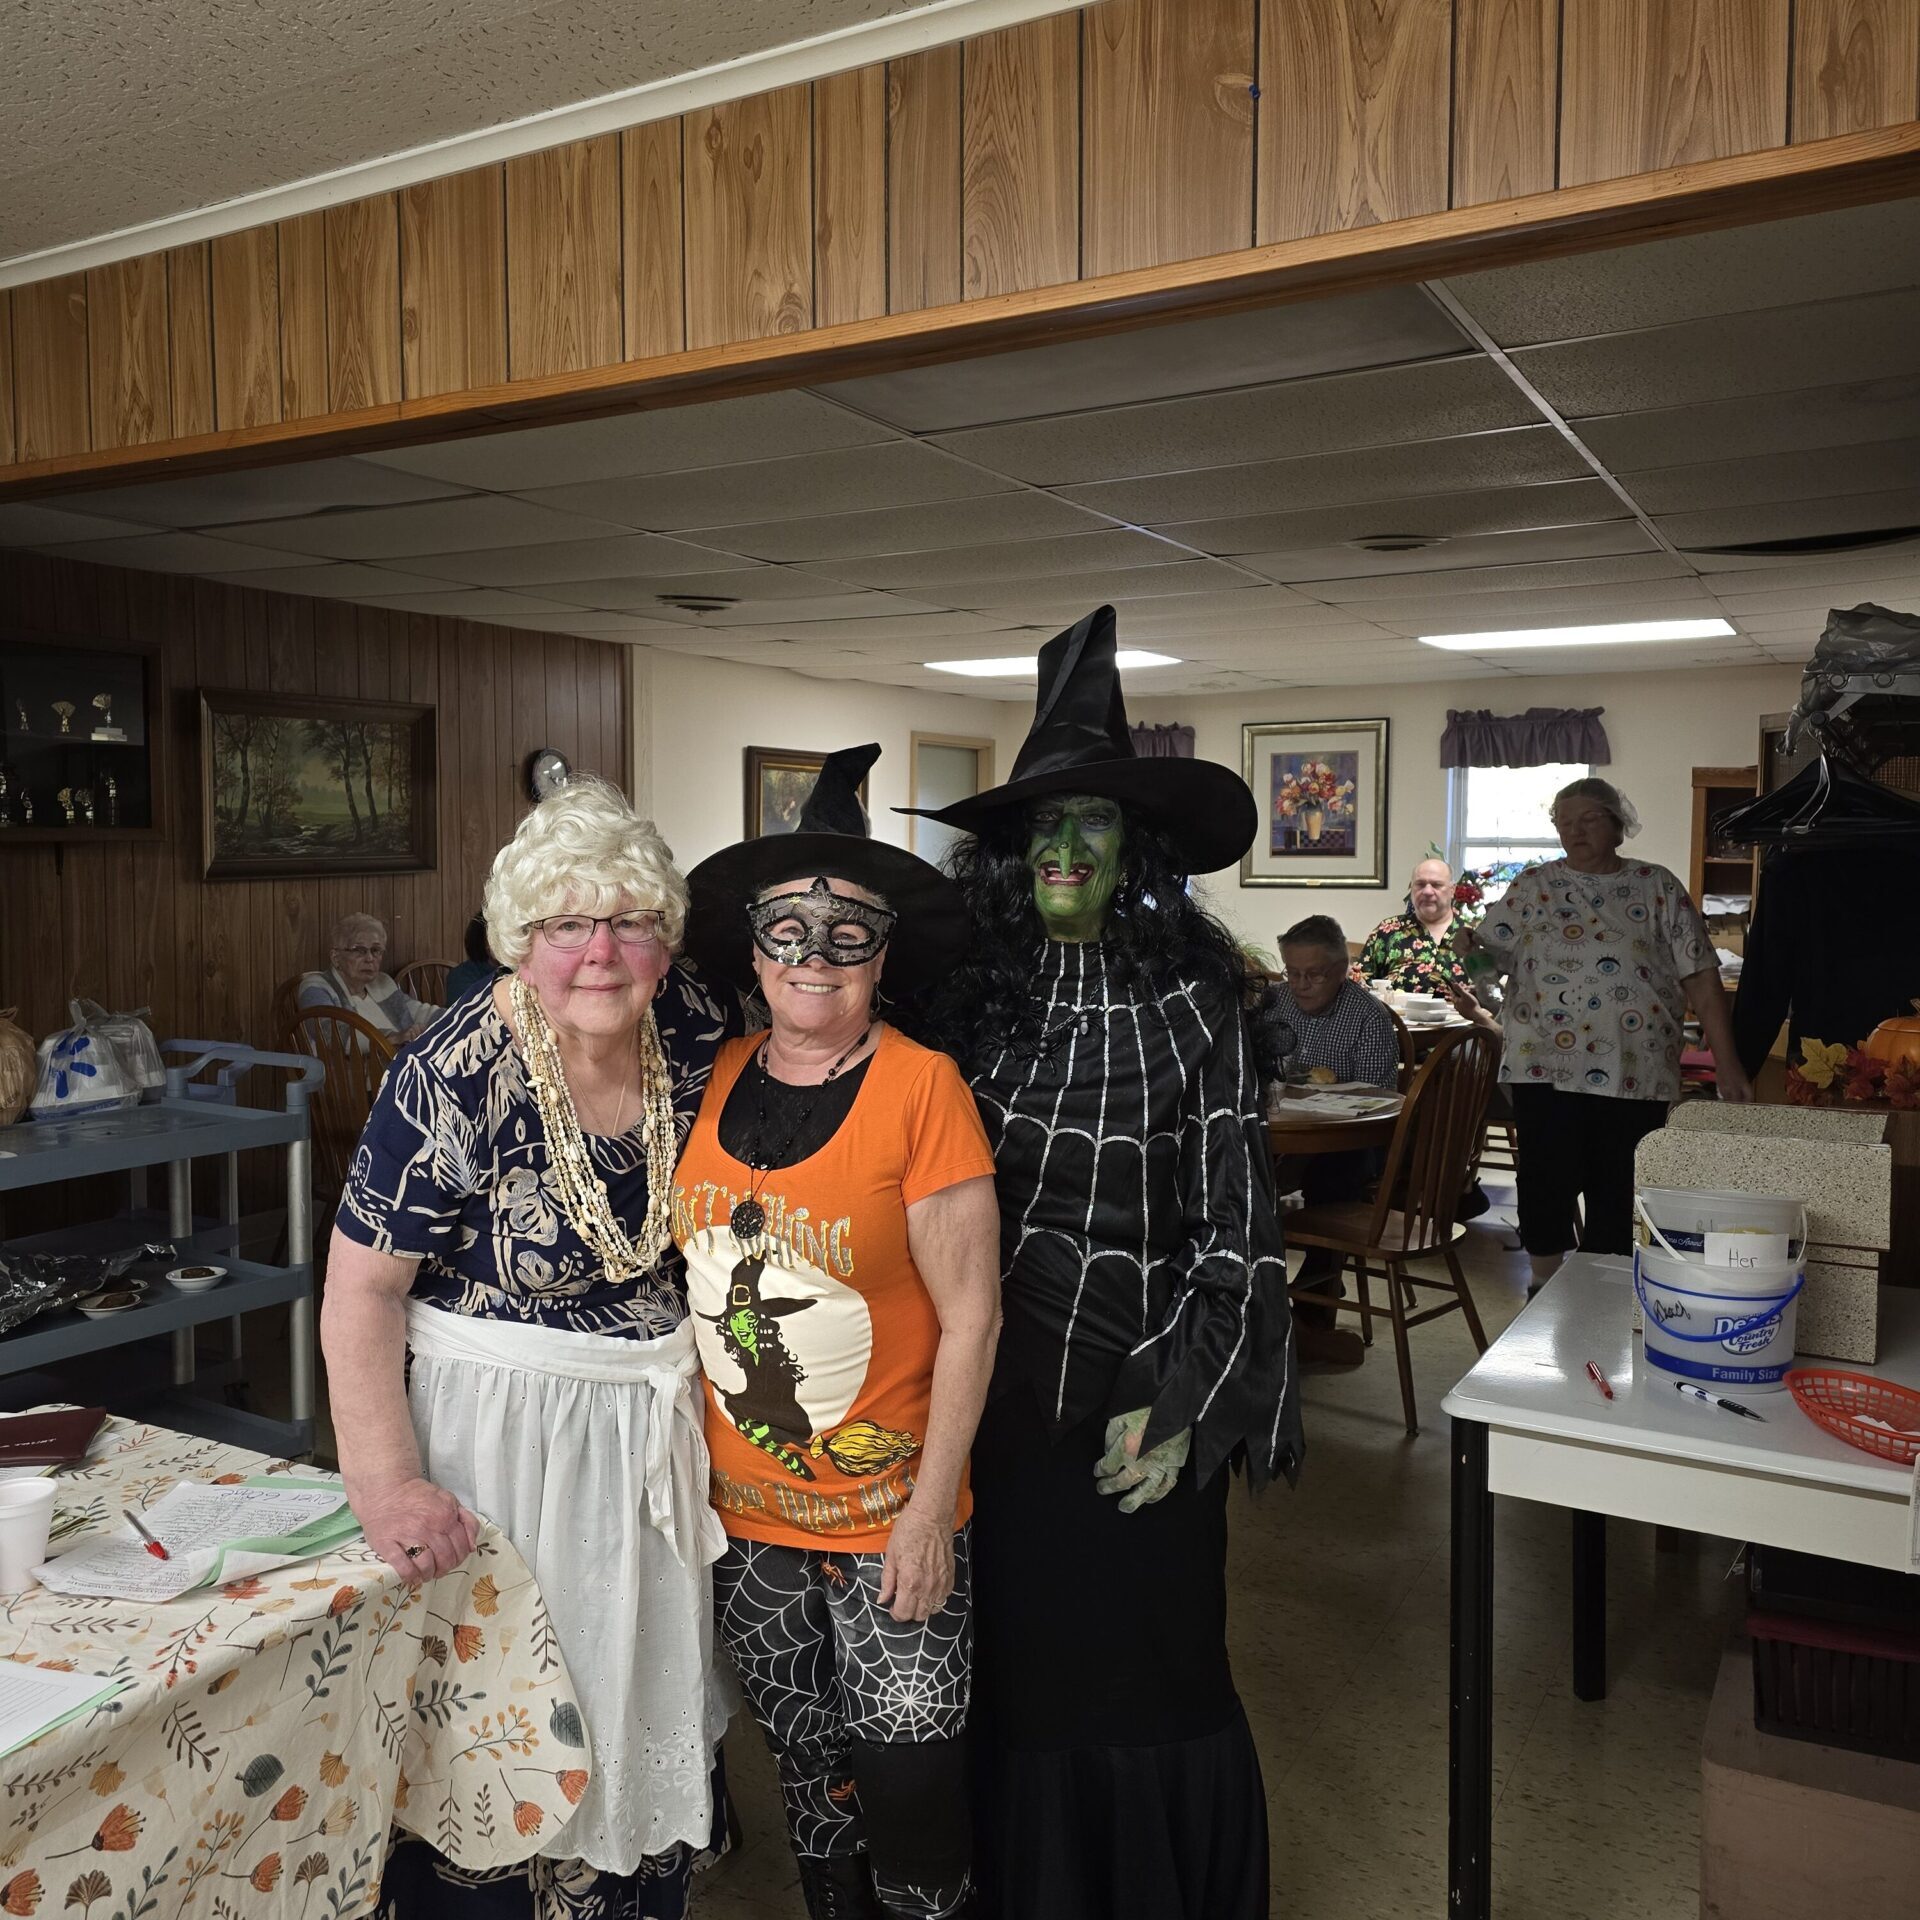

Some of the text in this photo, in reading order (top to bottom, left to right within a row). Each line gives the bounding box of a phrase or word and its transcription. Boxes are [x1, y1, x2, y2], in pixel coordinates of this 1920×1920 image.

[1728, 1247, 1758, 1268] Her
[1729, 1327, 1775, 1345] Country
[1738, 1337, 1771, 1352] Fresh
[1712, 1367, 1779, 1382] Family Size
